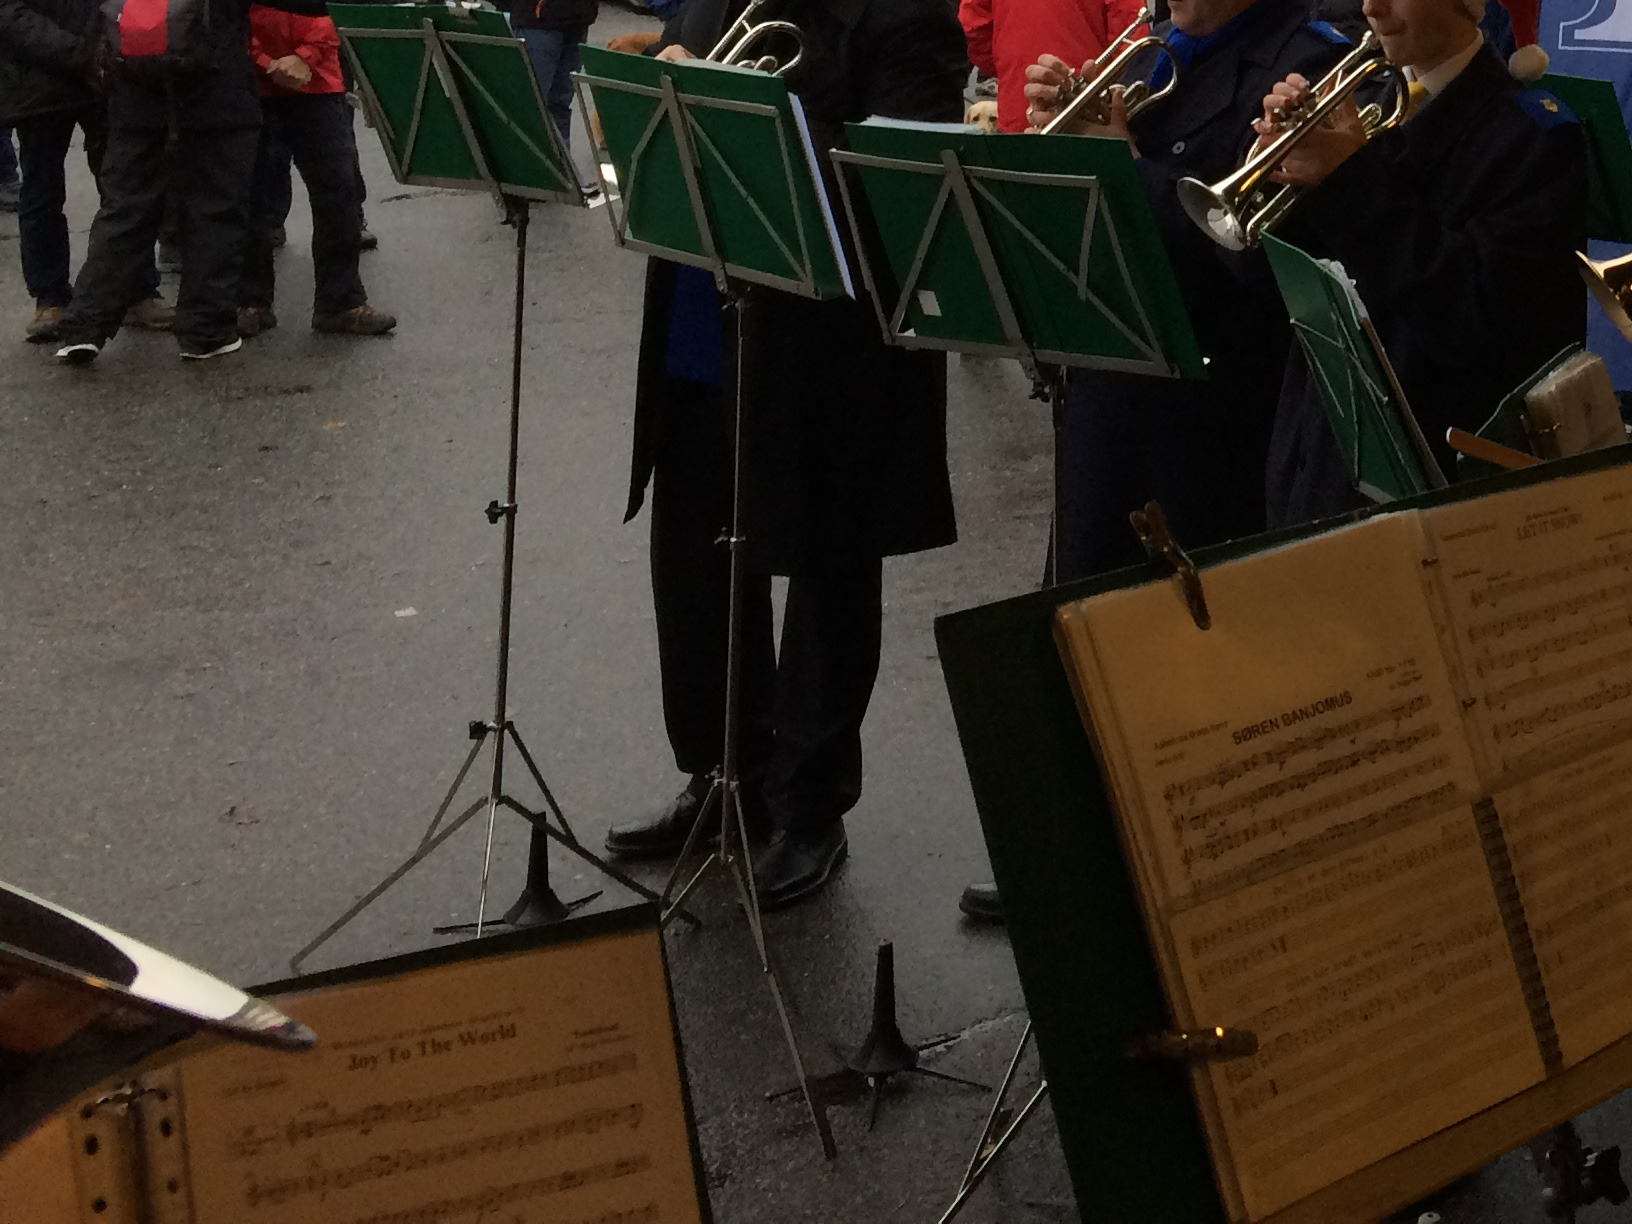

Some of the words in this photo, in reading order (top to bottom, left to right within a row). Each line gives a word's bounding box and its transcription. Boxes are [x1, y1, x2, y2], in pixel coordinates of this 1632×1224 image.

[1231, 717, 1280, 745] SØREN
[1281, 690, 1353, 727] BANJOMUS
[348, 1051, 379, 1072] Joy
[388, 1044, 411, 1063] To
[417, 1037, 452, 1057] The
[457, 1021, 517, 1047] World
